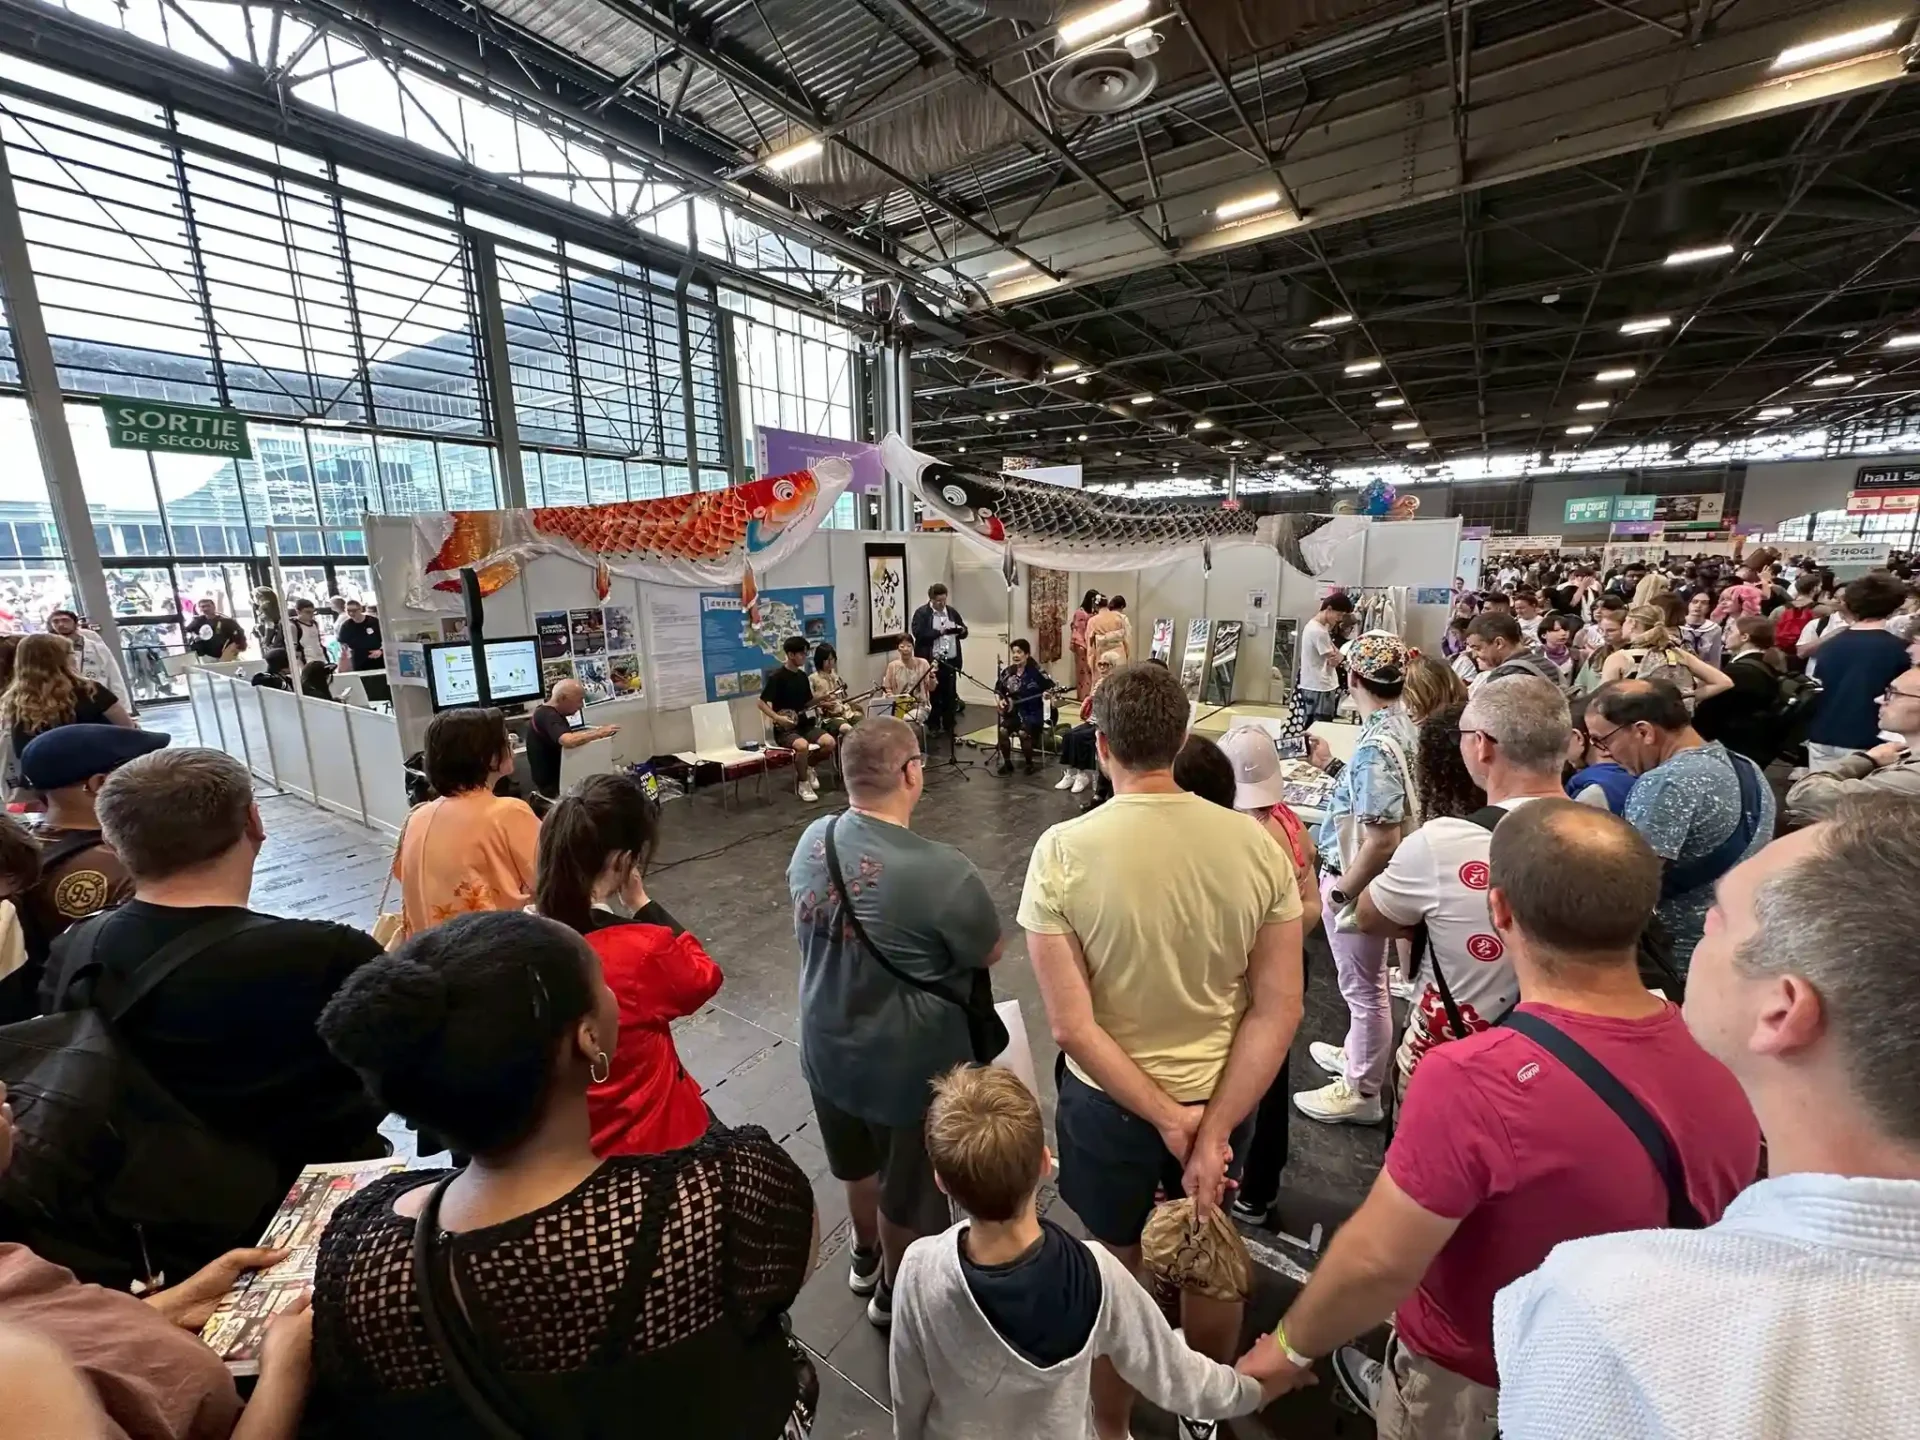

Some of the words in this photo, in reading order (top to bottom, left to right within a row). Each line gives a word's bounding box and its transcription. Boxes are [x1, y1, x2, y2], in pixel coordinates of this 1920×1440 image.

[118, 408, 237, 437] SORTIE
[122, 430, 149, 443] DE
[158, 434, 240, 451] SECOURS
[1864, 471, 1899, 482] hall
[69, 884, 95, 903] 95
